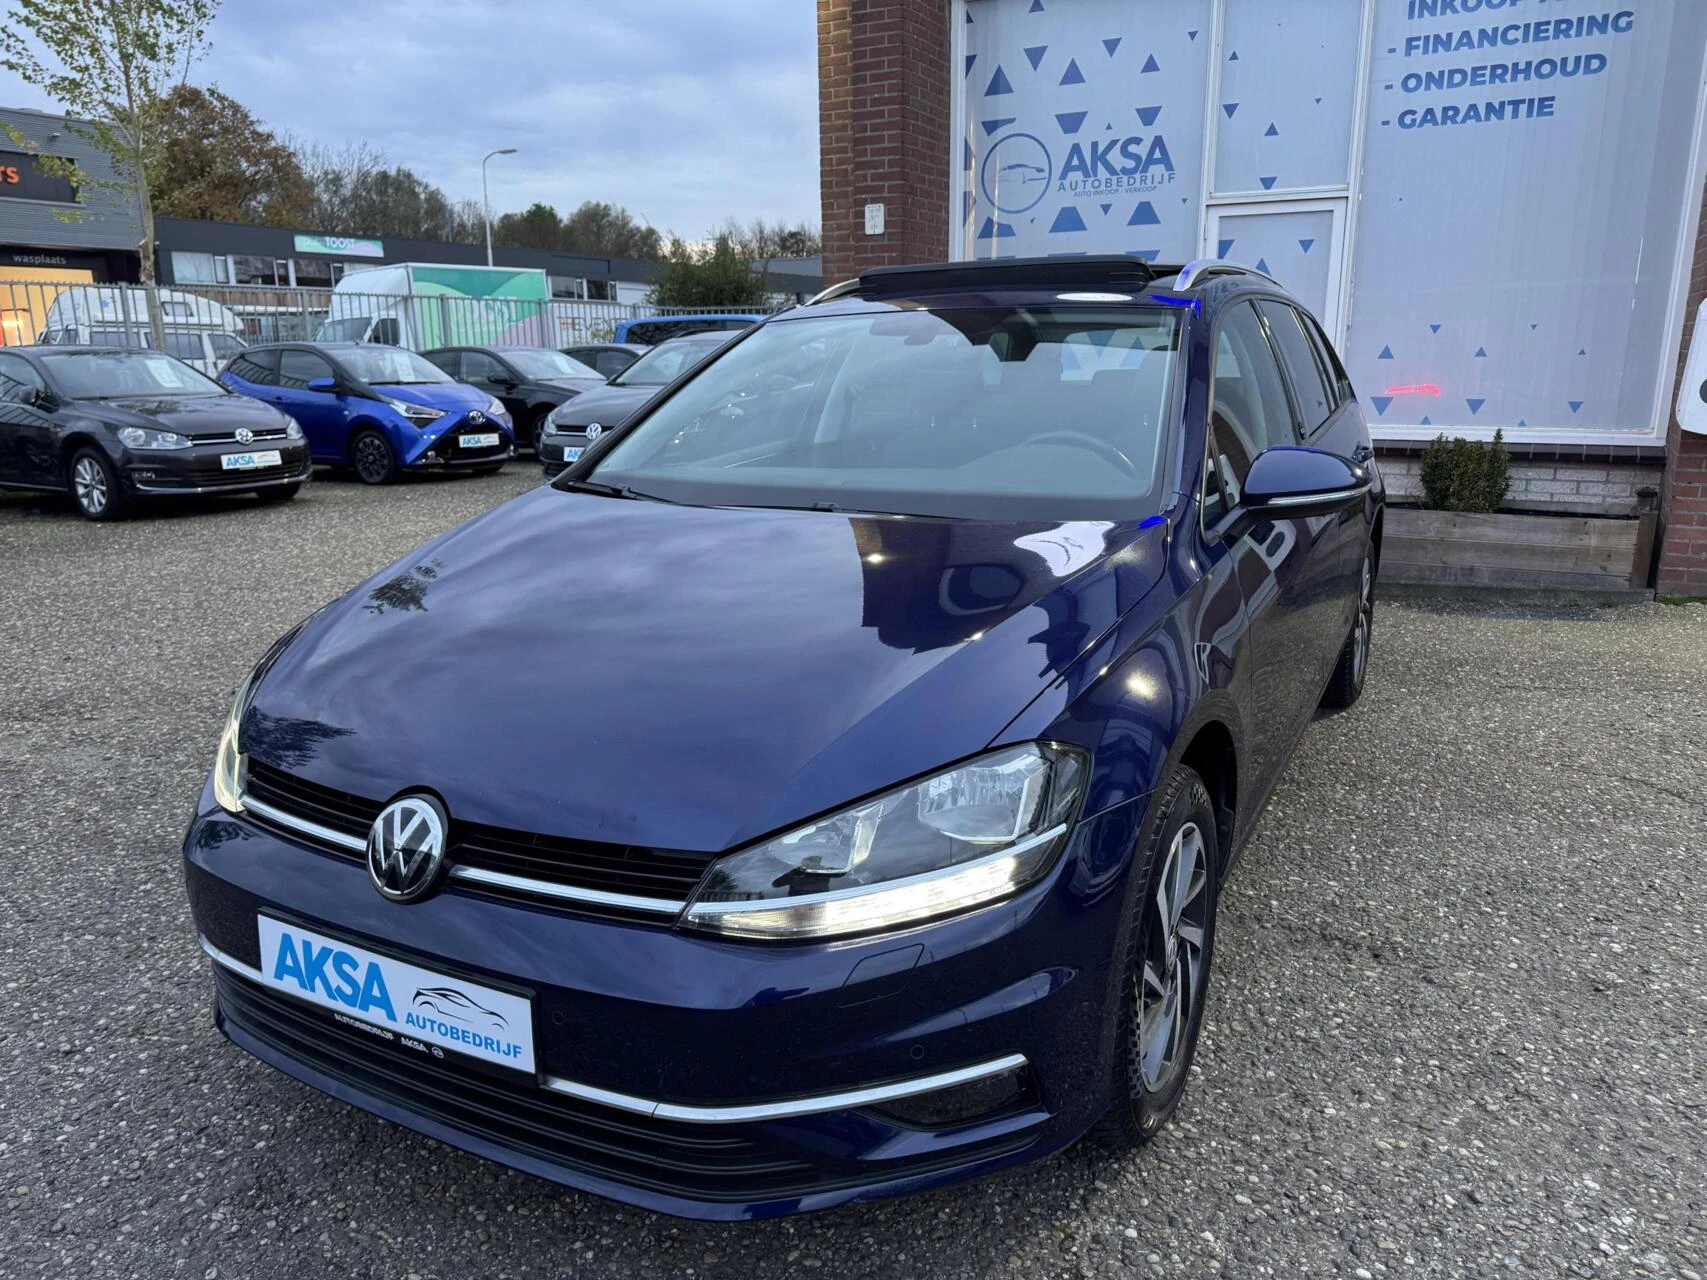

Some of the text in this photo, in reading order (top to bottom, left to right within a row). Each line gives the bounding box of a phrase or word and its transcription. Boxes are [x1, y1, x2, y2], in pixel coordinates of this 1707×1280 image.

[1404, 11, 1634, 57] FINANCIERING
[1401, 53, 1608, 94] ONDERHOUD
[1398, 96, 1556, 130] GARANTIE
[1058, 135, 1175, 181] AKSA
[1057, 173, 1176, 192] AUTOBEDRIJF
[1074, 189, 1092, 198] AUTO
[1093, 187, 1120, 197] INKOOP
[1125, 185, 1158, 194] VERKOOP
[324, 236, 356, 249] TOOST
[12, 253, 67, 265] wasplaats
[463, 436, 482, 446] AKSA
[226, 455, 256, 467] AKSA
[273, 932, 398, 1024] AKSA
[405, 1011, 523, 1060] AUTOBEDRIJF
